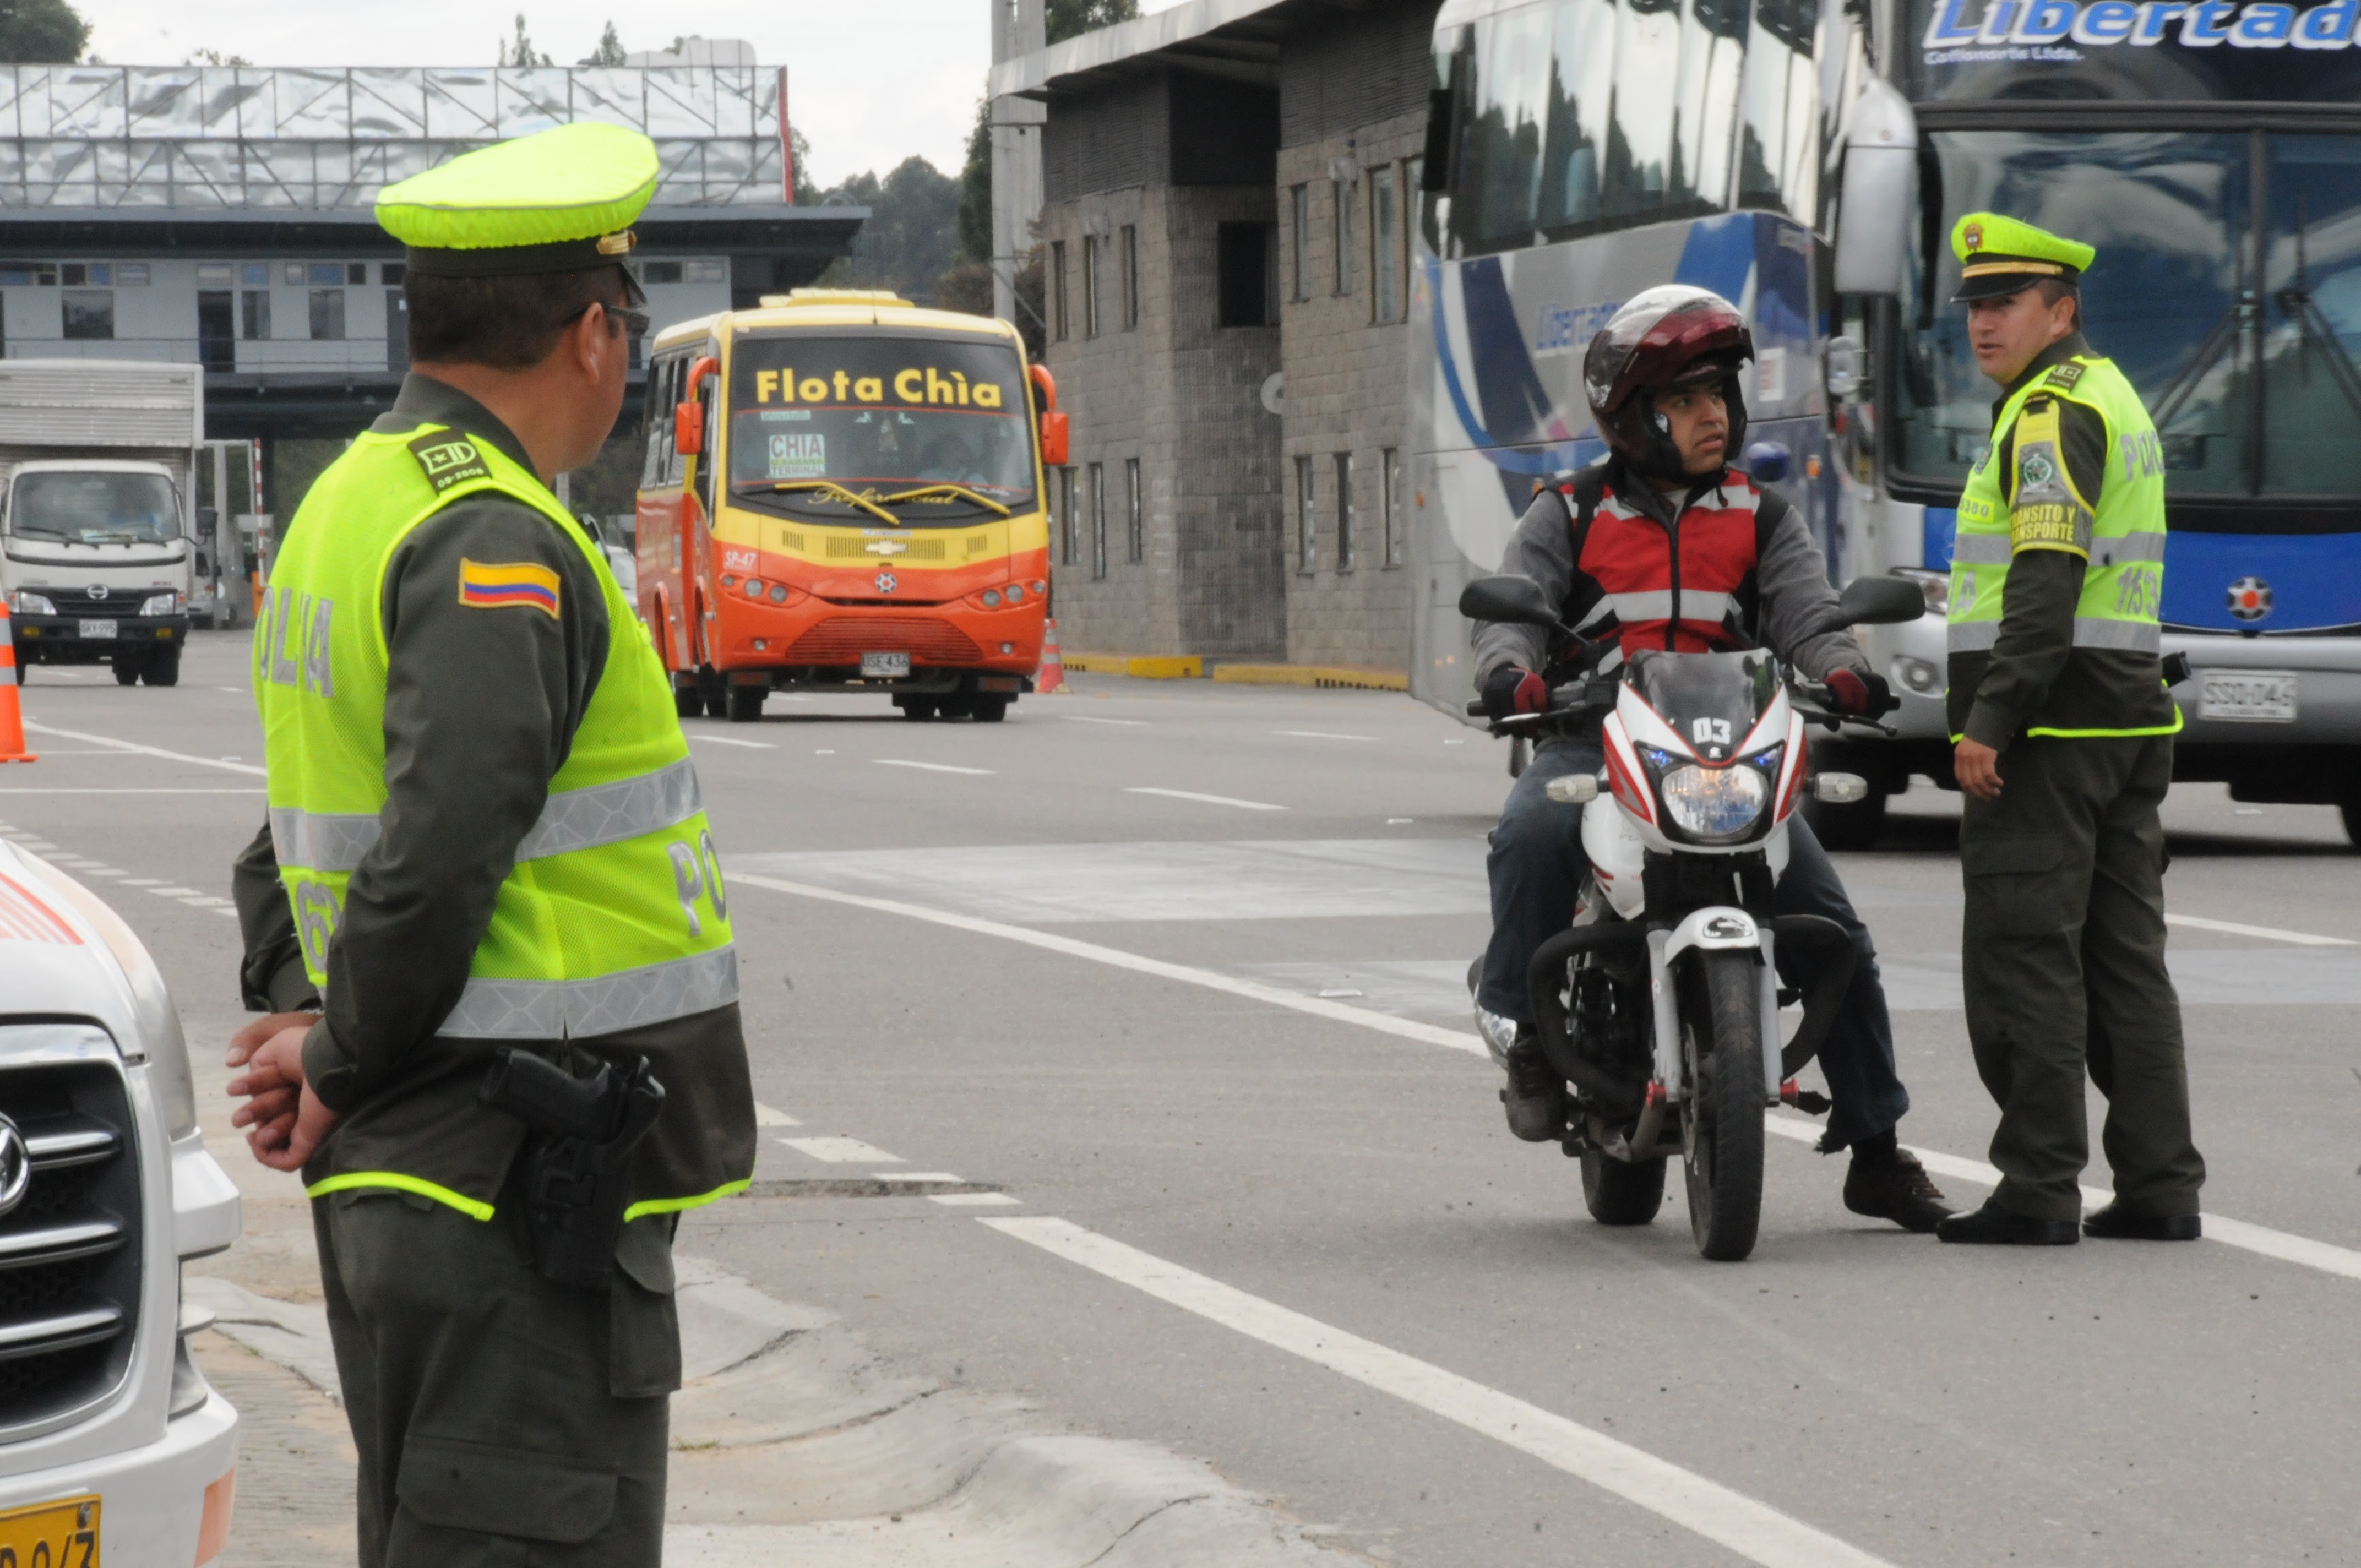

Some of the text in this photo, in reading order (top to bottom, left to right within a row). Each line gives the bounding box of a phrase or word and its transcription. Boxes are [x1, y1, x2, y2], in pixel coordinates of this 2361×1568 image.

[1922, 0, 2361, 49] Libertad
[757, 367, 883, 404] Flota
[771, 434, 822, 458] CHIA
[771, 466, 825, 476] TERMINAL
[2067, 506, 2076, 524] Y
[724, 551, 757, 567] SP-47
[1693, 716, 1731, 744] 03
